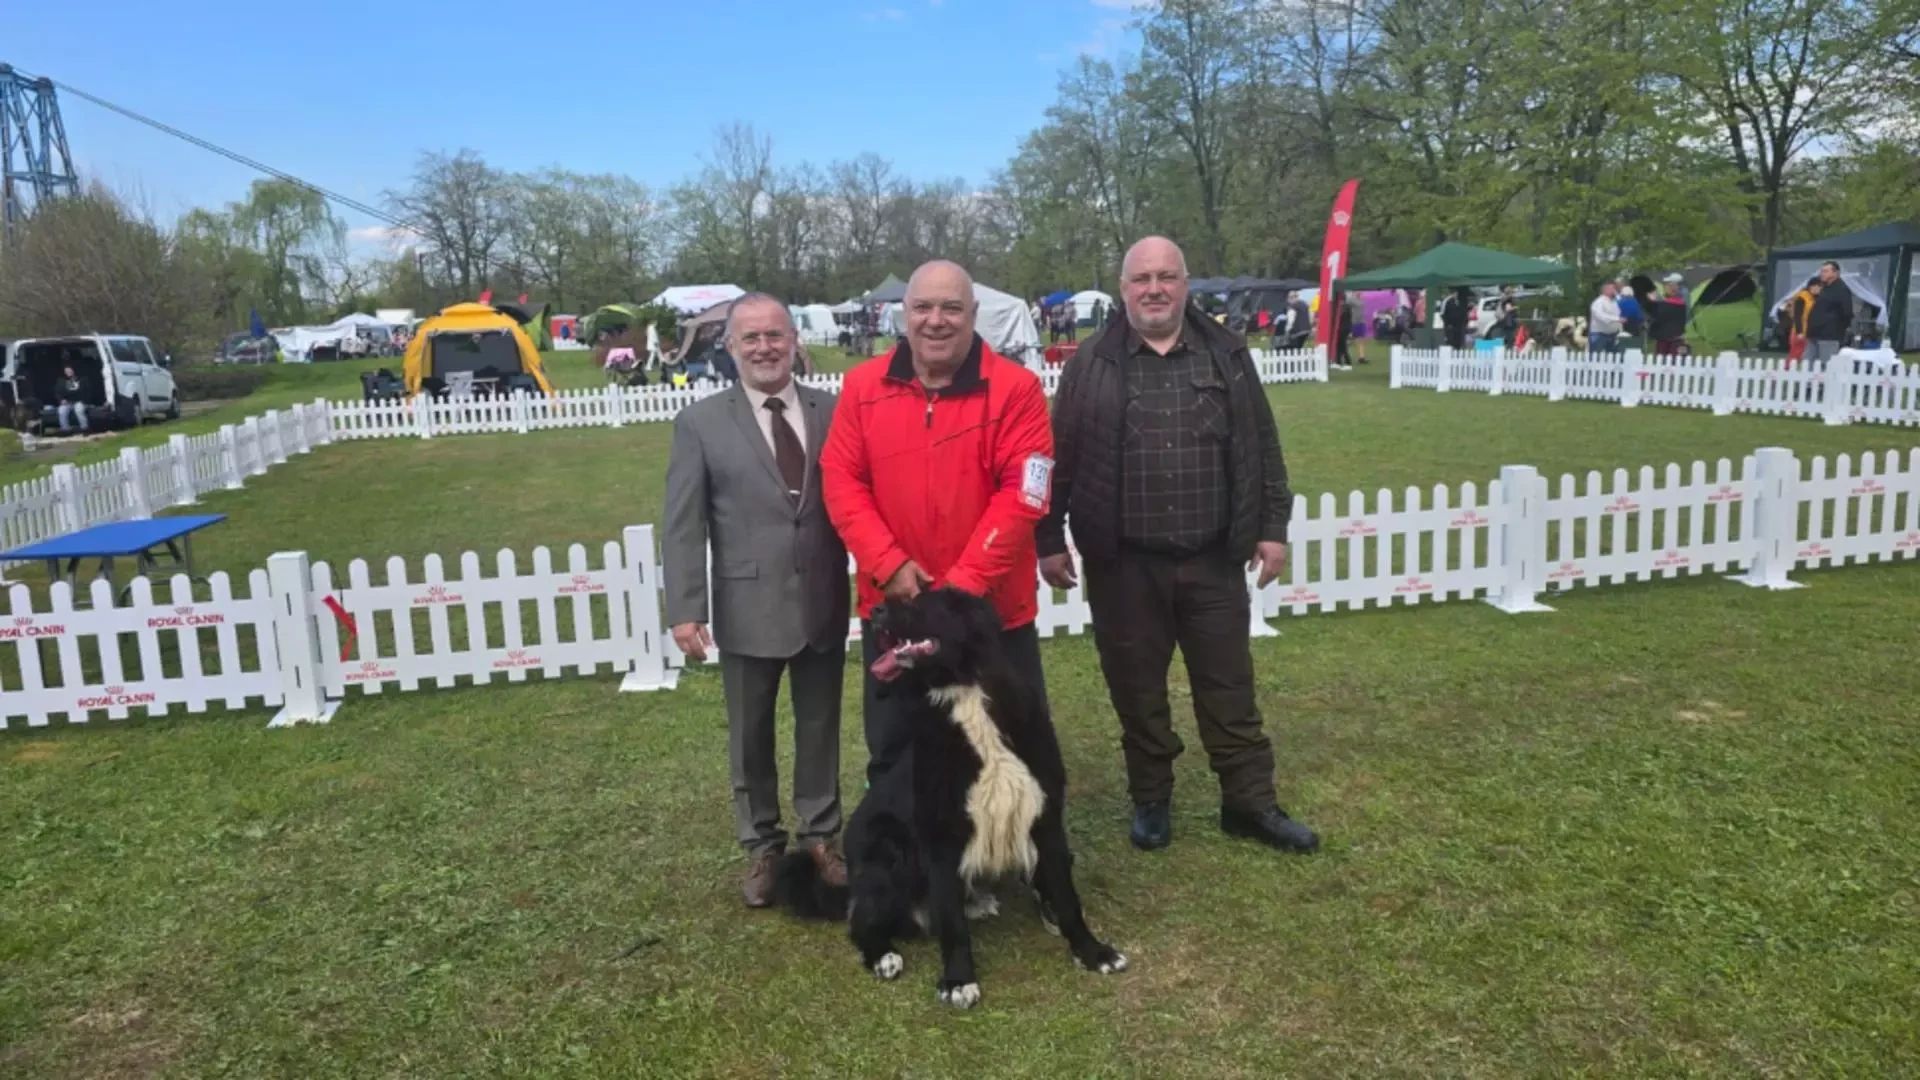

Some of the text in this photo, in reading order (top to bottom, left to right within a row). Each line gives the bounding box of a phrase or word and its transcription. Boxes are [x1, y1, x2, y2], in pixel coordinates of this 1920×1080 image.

[147, 613, 224, 628] ROYAL CANIN
[25, 624, 65, 636] CANIN
[77, 692, 155, 708] ROYAL CANIN
